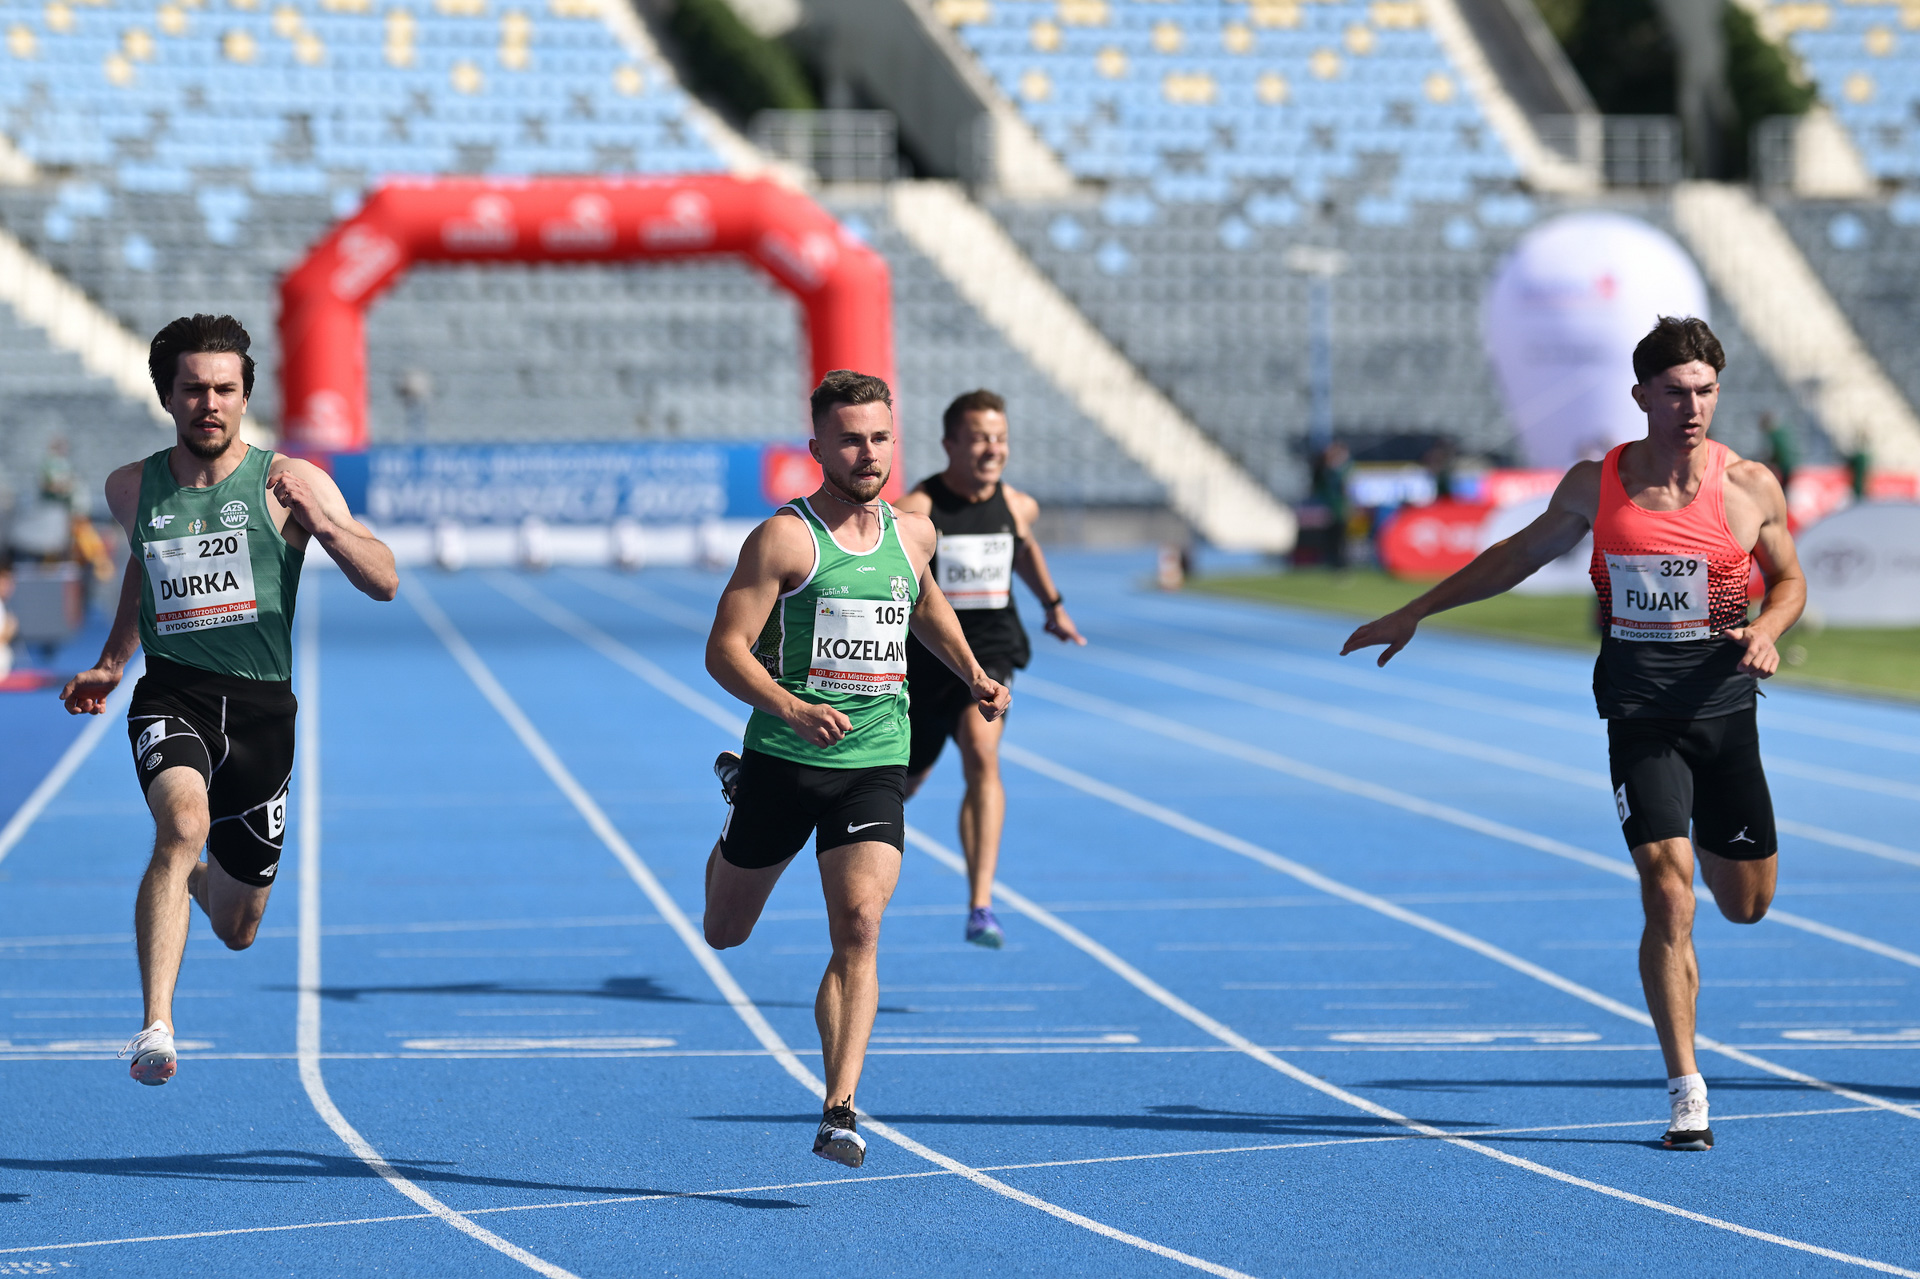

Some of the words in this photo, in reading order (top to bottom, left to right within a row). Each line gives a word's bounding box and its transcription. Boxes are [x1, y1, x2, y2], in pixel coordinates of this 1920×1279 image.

[198, 536, 238, 558] 220
[1660, 559, 1698, 577] 329
[160, 570, 239, 600] DURKA
[1626, 589, 1690, 611] FUJAK
[168, 612, 184, 620] PZLA
[184, 606, 228, 618] Mistrzostwa
[229, 602, 251, 612] Polski
[875, 606, 905, 625] 105
[165, 617, 219, 631] BYDGOSZCZ
[220, 614, 244, 624] 2025
[1683, 620, 1704, 628] Polski
[1620, 629, 1672, 639] BYDGOSZCZ
[1674, 630, 1697, 639] 2025
[817, 637, 905, 662] KOZELAN
[829, 671, 846, 679] PZLA
[821, 680, 878, 692] BYDGOSZCZ
